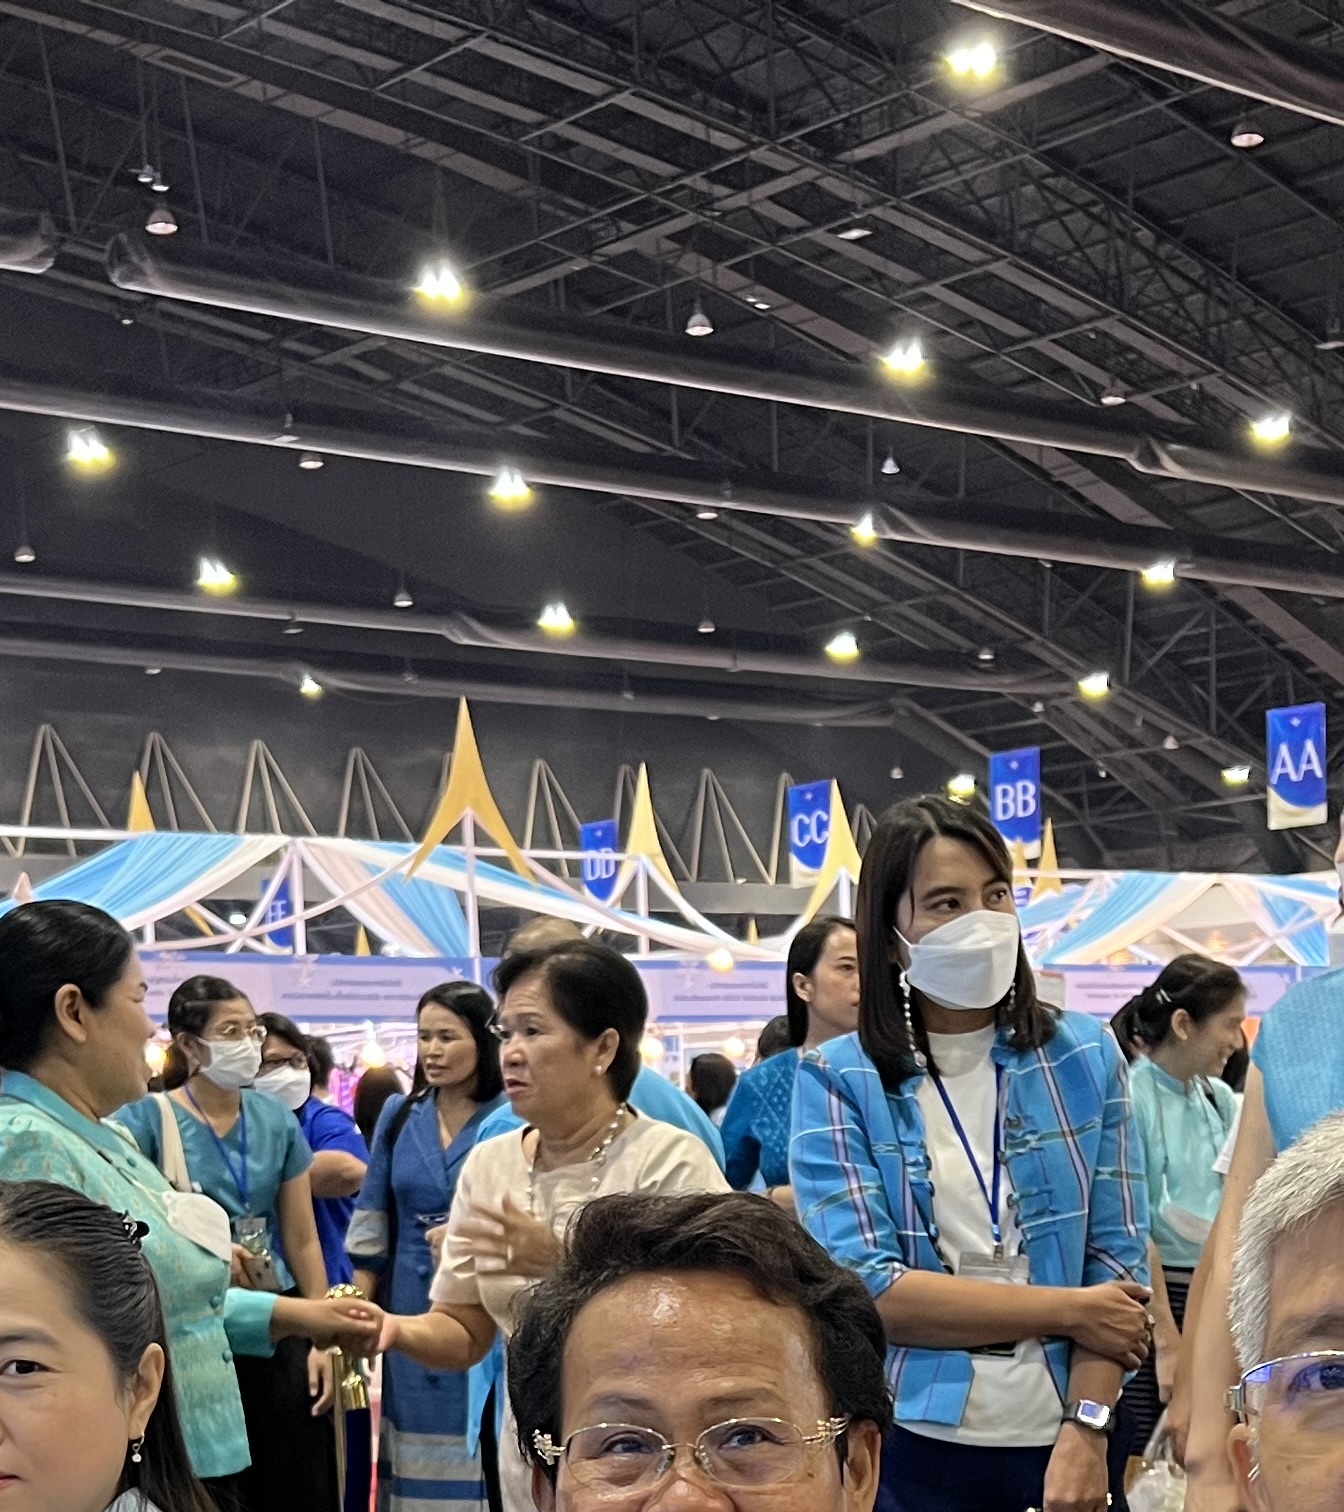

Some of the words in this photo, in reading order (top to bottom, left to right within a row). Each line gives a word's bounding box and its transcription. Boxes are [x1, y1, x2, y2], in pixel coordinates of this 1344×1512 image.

[1270, 738, 1324, 785] AA
[994, 779, 1037, 821] BB
[791, 810, 829, 848] CC
[583, 847, 615, 881] DD
